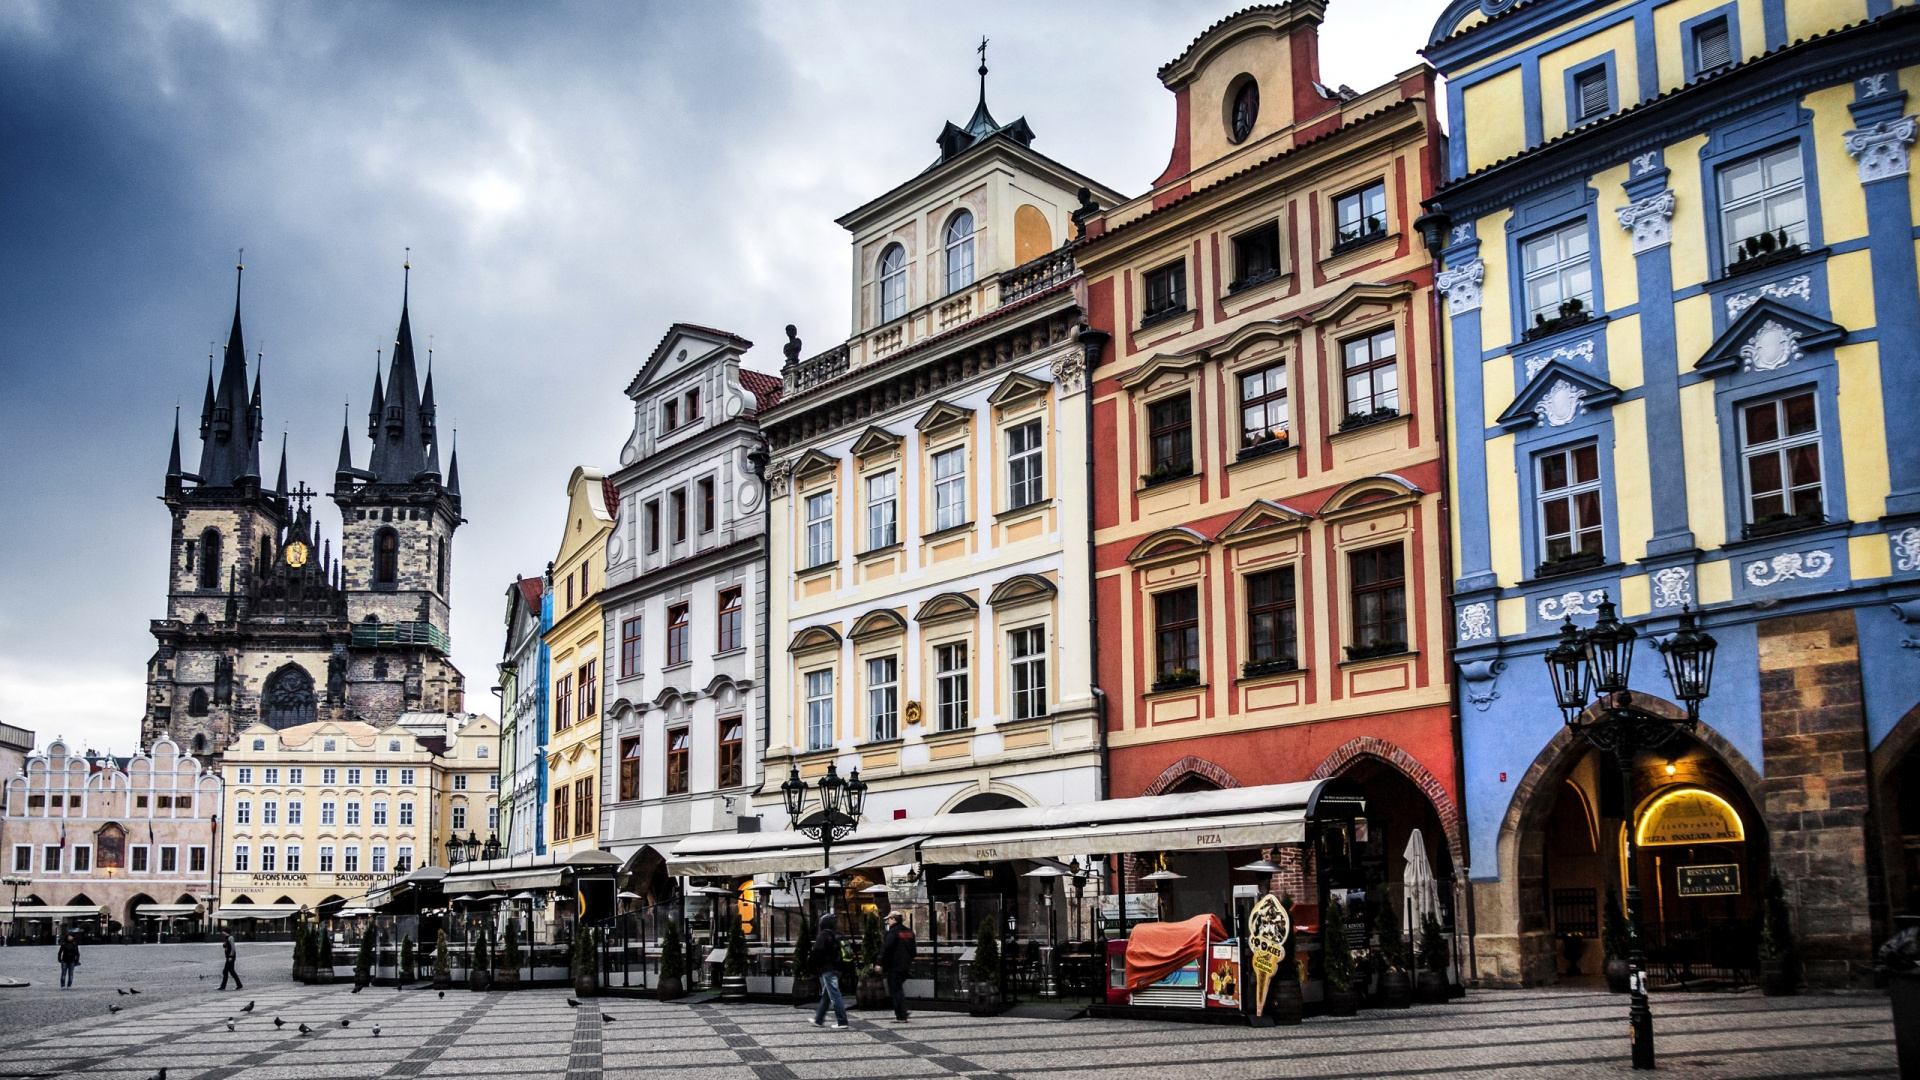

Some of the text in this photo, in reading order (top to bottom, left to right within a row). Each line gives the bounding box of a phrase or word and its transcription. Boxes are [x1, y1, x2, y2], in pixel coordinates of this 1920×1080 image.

[1196, 834, 1222, 844] PIZZA
[1672, 833, 1711, 841] INSALATA
[976, 849, 998, 858] PASTA
